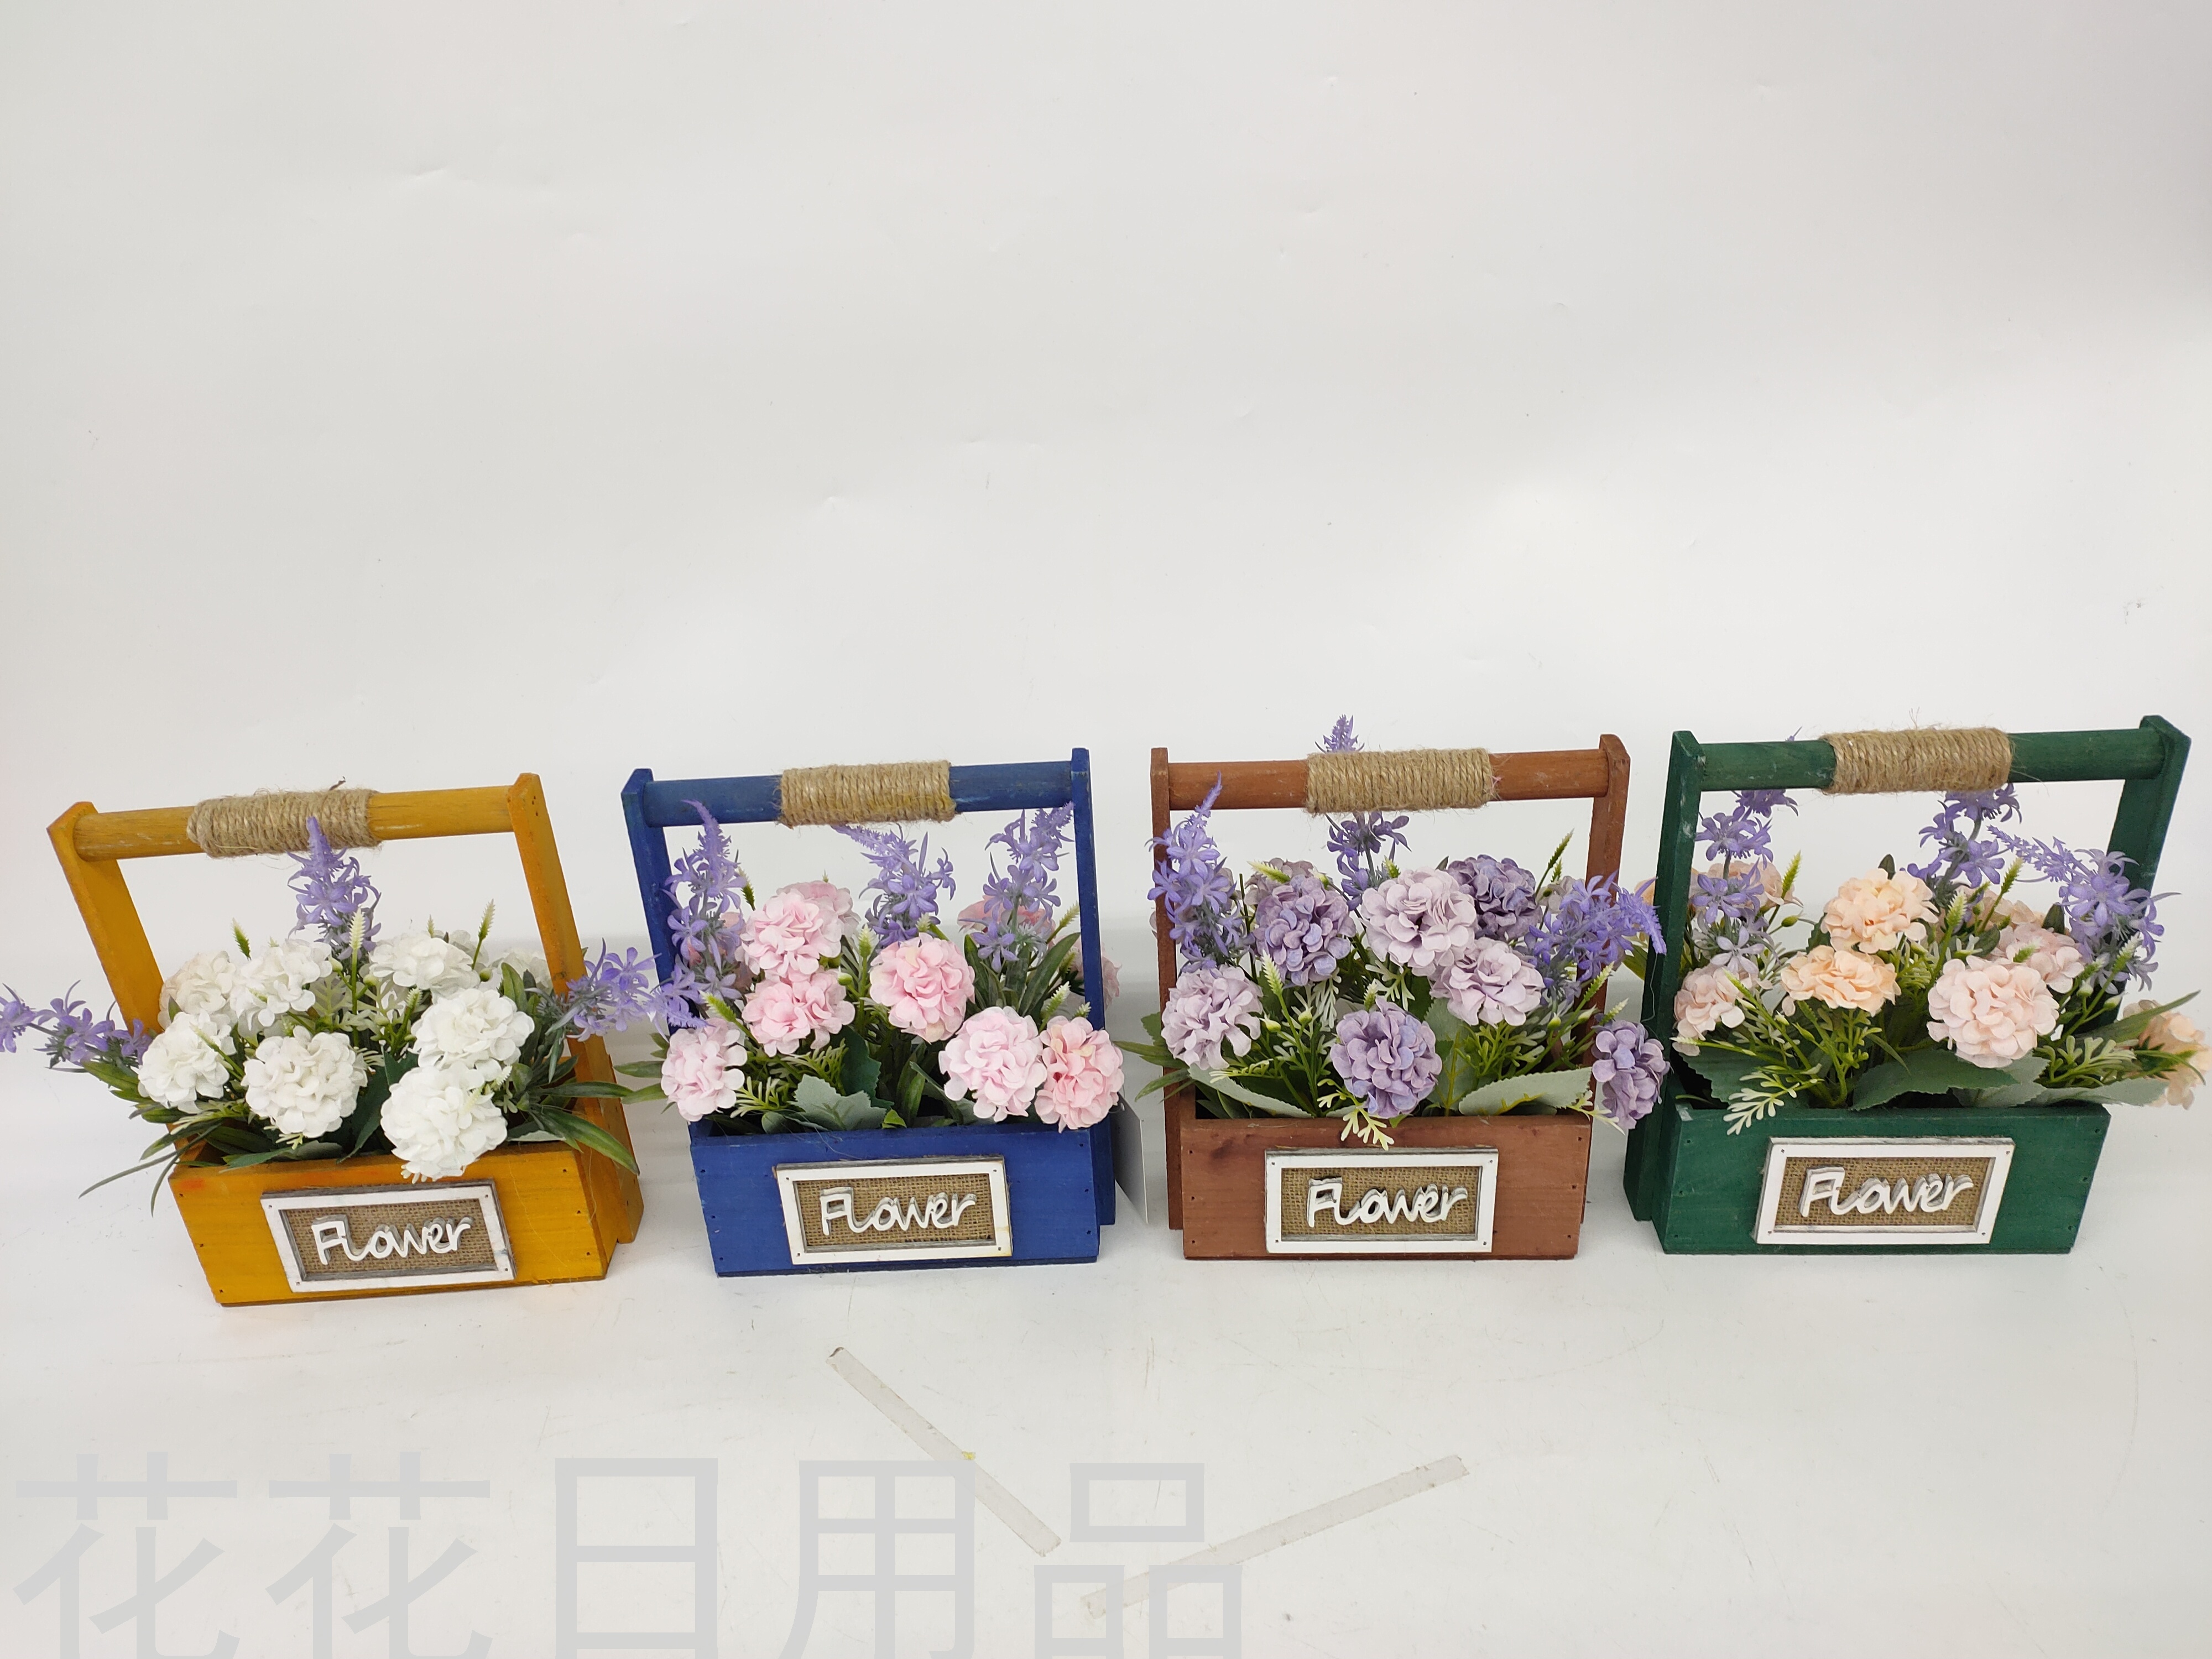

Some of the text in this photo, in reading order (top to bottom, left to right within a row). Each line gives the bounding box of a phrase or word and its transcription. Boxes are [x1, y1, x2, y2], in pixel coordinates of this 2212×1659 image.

[820, 1186, 977, 1236] Flower
[1307, 1177, 1468, 1228] Flower
[1798, 1166, 1974, 1217] Flower
[311, 1215, 473, 1265] Flower
